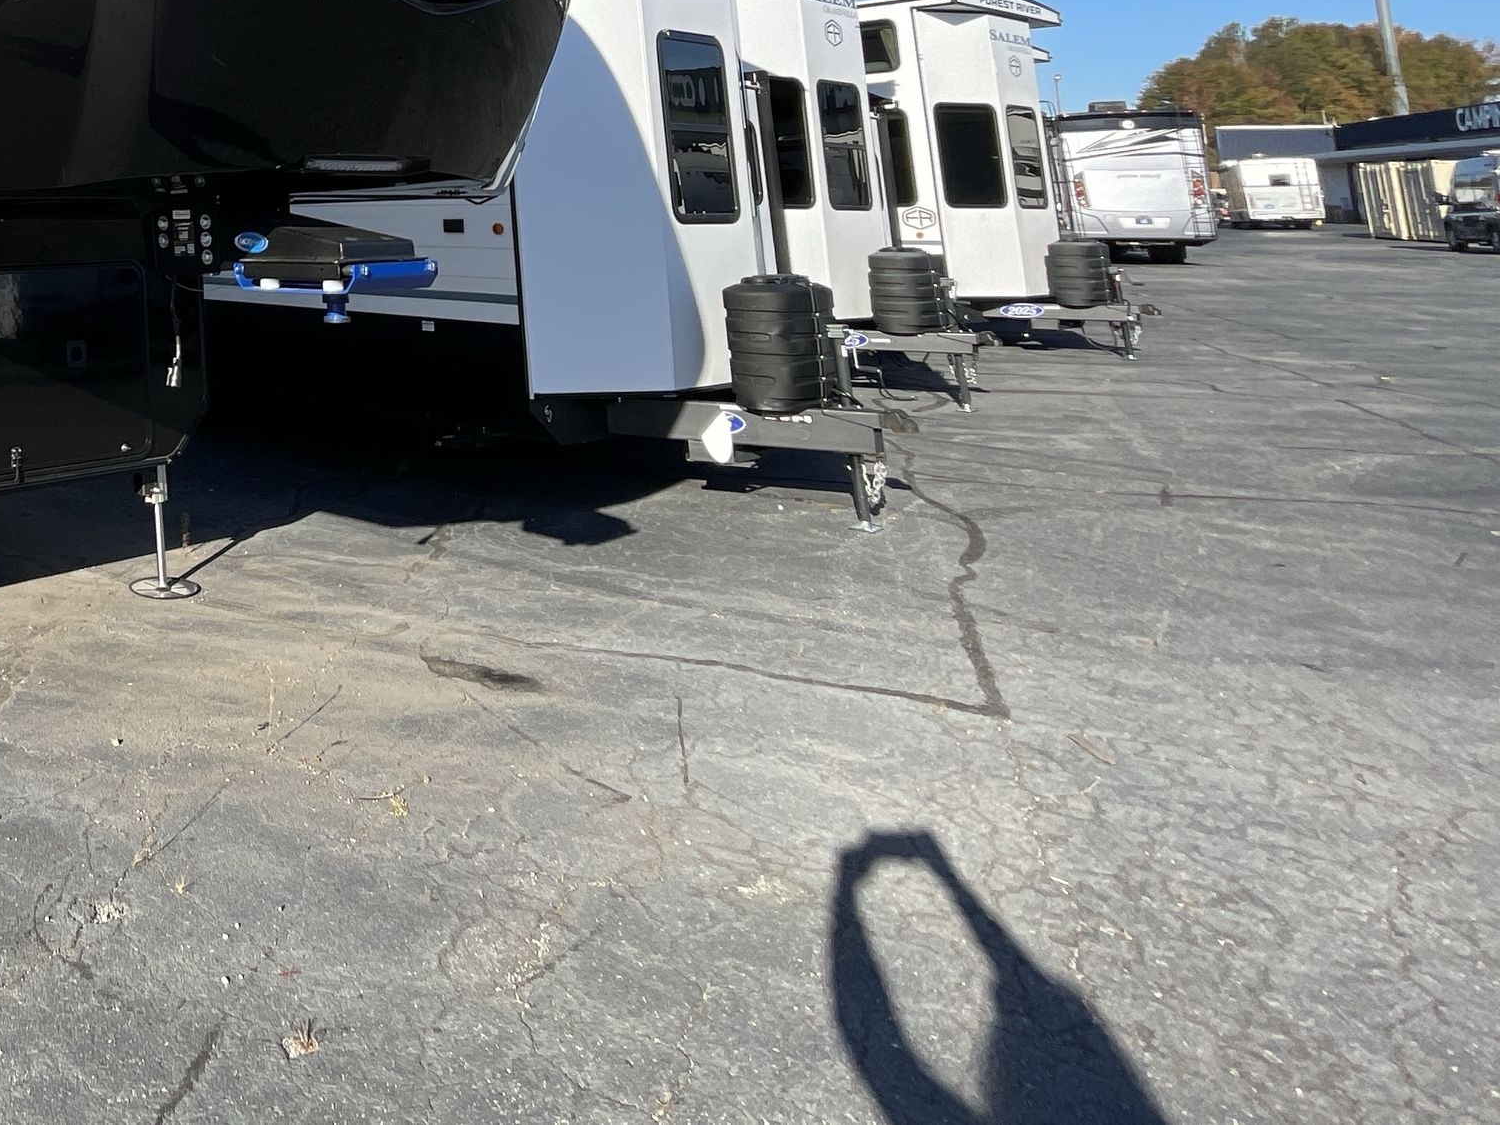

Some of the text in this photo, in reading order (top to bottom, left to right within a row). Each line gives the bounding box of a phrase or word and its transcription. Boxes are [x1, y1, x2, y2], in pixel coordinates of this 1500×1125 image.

[1016, 3, 1041, 15] RIVER
[989, 29, 1031, 46] SALEM
[1007, 305, 1037, 315] 2025
